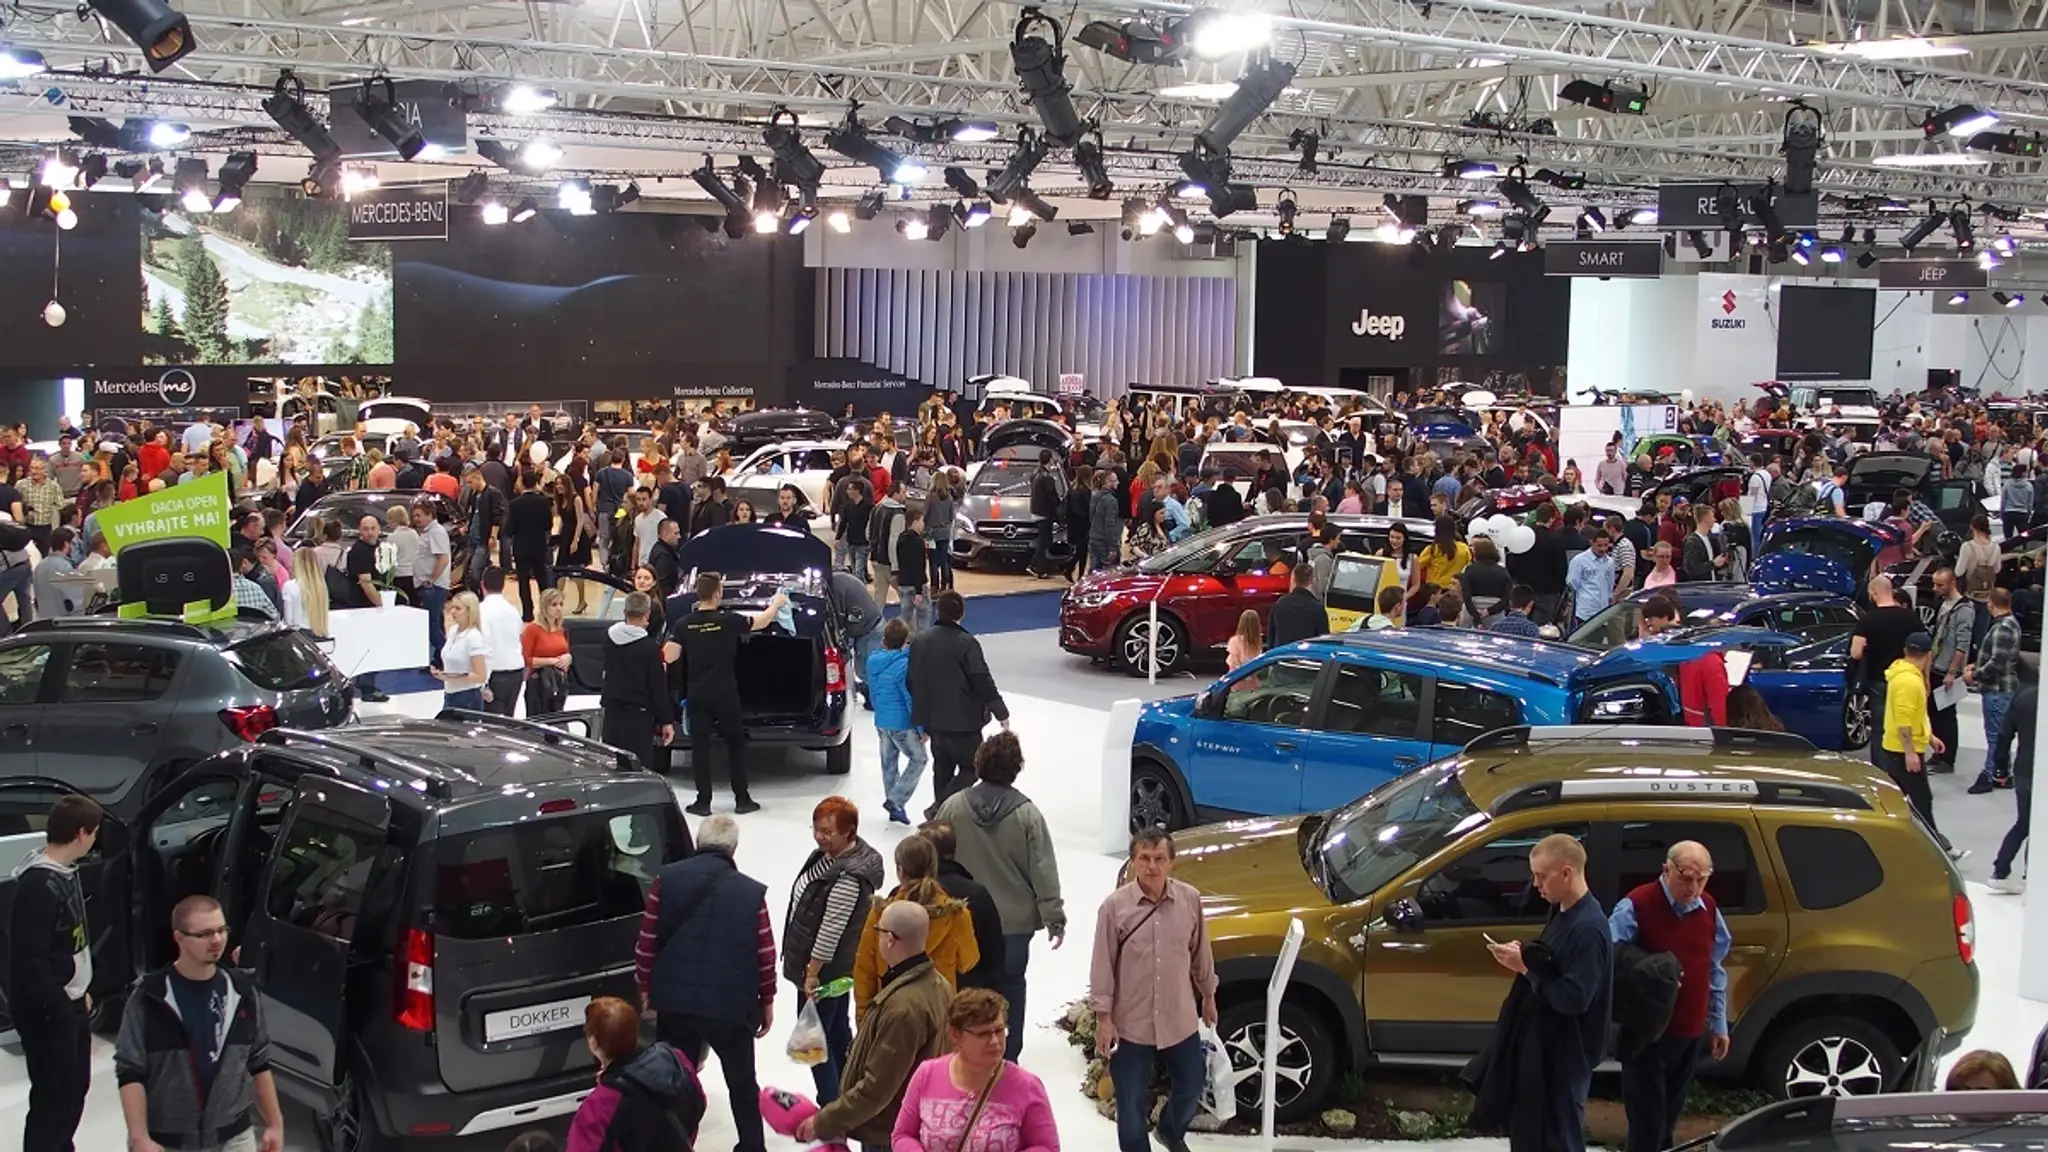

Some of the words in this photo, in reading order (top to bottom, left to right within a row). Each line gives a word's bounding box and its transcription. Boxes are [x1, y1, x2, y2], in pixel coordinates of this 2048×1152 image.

[351, 201, 444, 224] MERCEDES-BENZ
[1698, 197, 1778, 215] REAUT
[1579, 251, 1624, 266] SMART
[1918, 267, 1947, 281] JEEP
[1352, 309, 1404, 340] Jeep
[1711, 318, 1746, 329] SUZUKI
[95, 380, 158, 394] Mercedes
[163, 382, 190, 392] me
[151, 500, 185, 515] DACIA
[187, 495, 218, 510] OPEN
[114, 514, 189, 537] VYHRAJTE
[193, 512, 220, 527] MA!
[1196, 740, 1241, 753] STEPWAY
[1650, 783, 1749, 792] DUSTER
[510, 1006, 570, 1029] DOKKER
